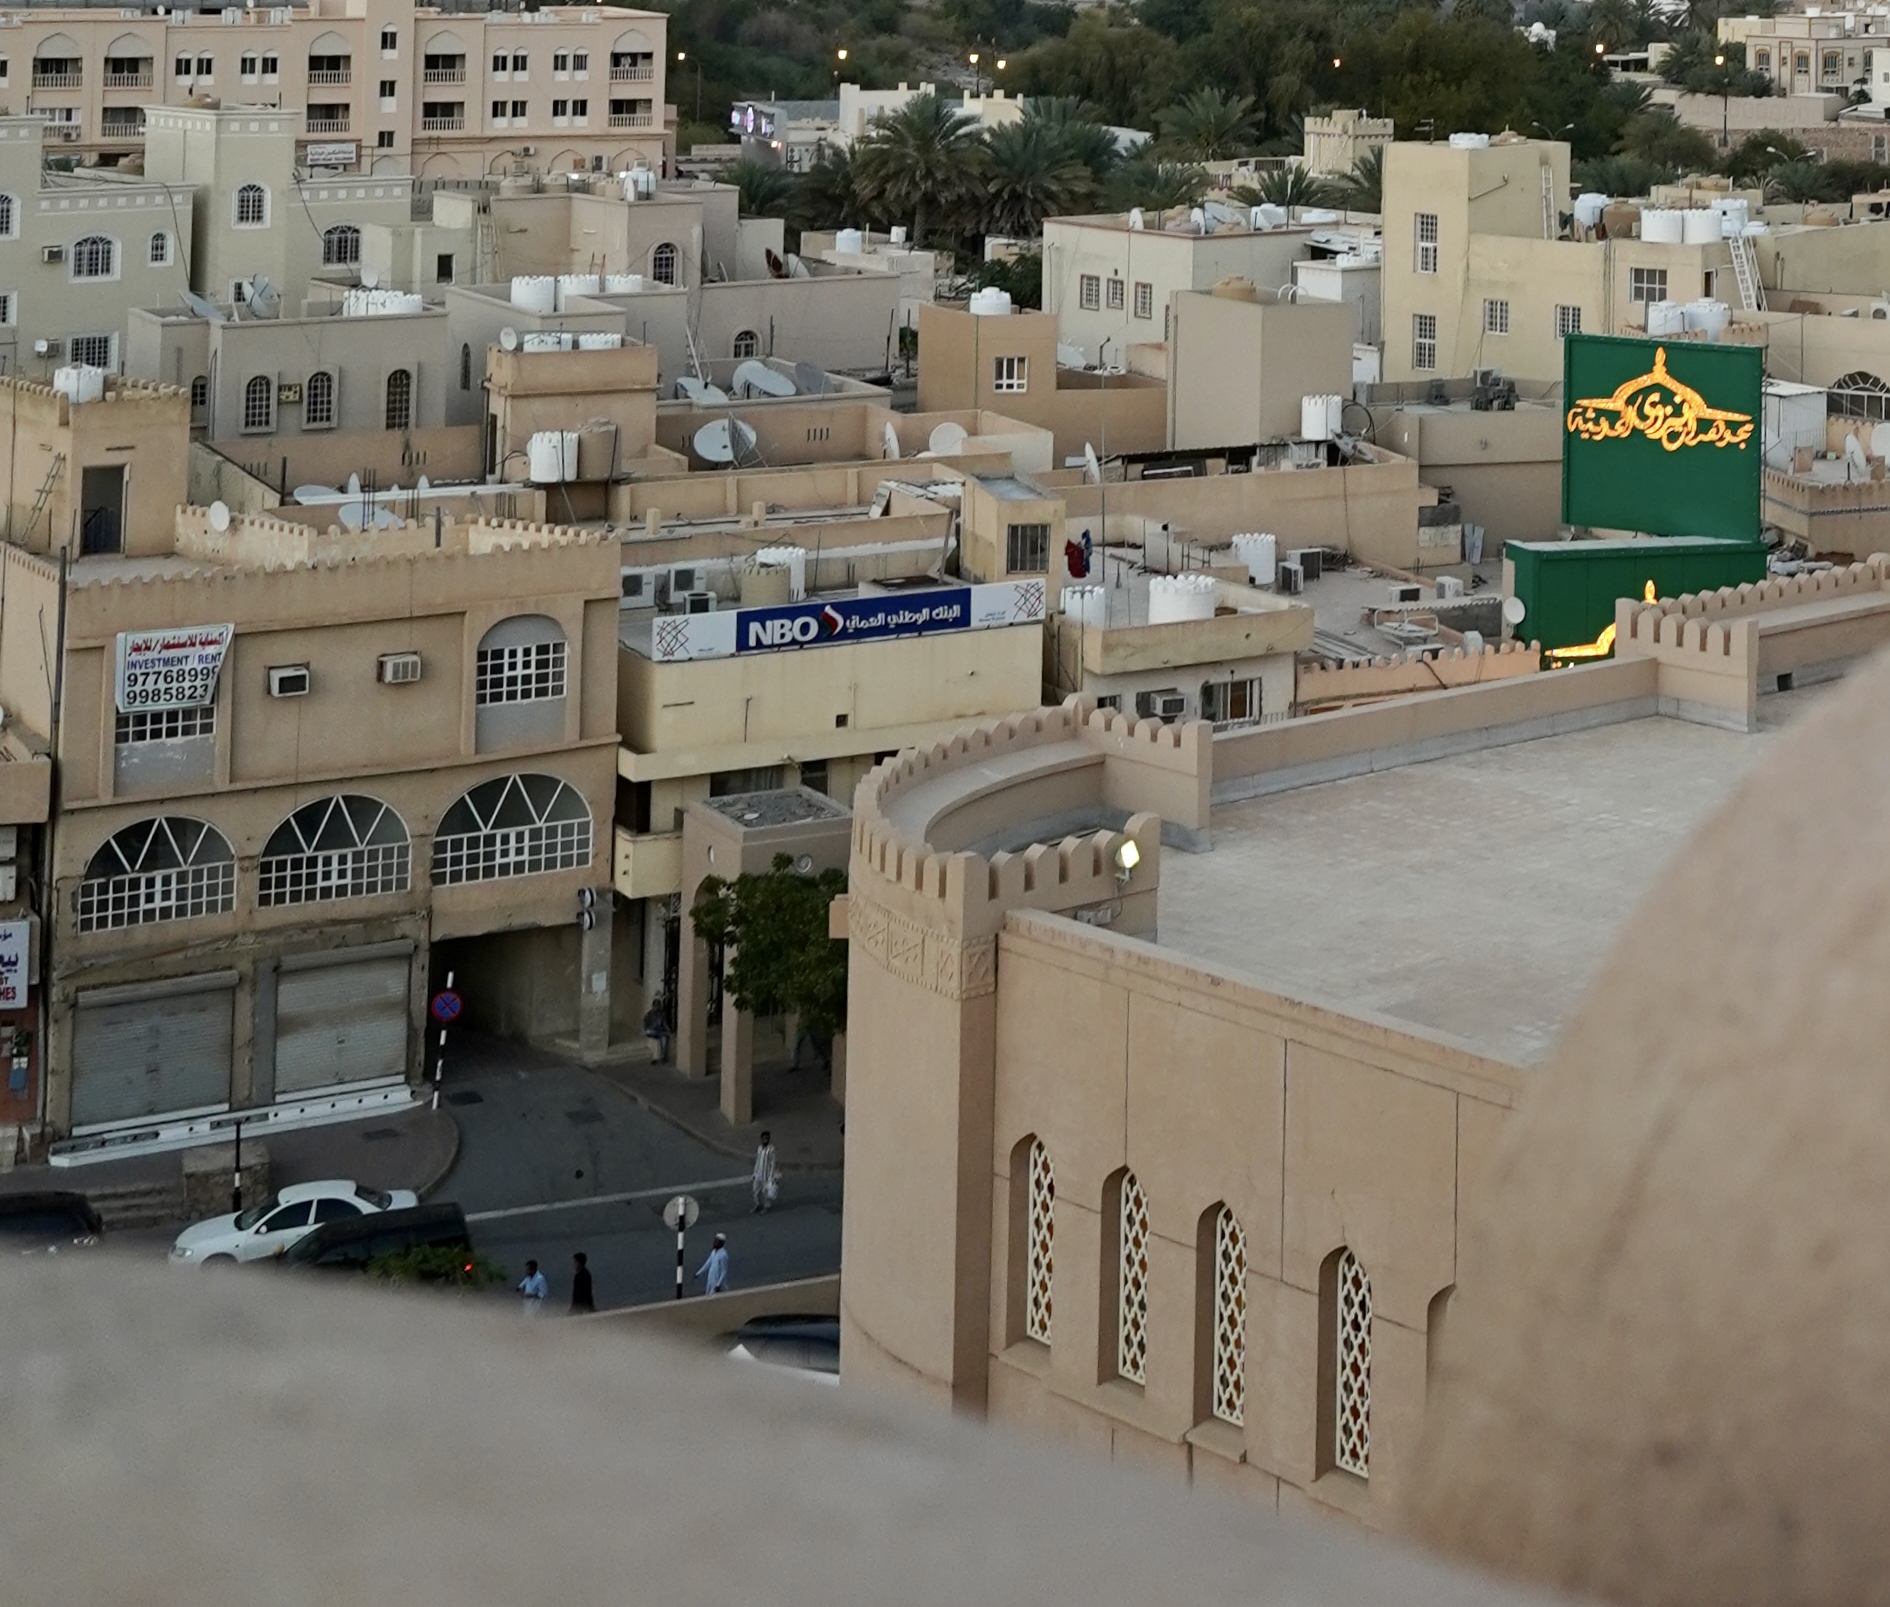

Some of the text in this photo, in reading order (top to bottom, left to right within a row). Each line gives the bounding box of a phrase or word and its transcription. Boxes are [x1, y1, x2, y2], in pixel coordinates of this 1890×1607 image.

[845, 612, 886, 633] العماني
[887, 607, 930, 628] الوطني
[931, 604, 961, 622] البنك
[748, 615, 819, 647] NBO
[127, 655, 190, 672] INVESTMENT
[197, 652, 223, 666] RENT
